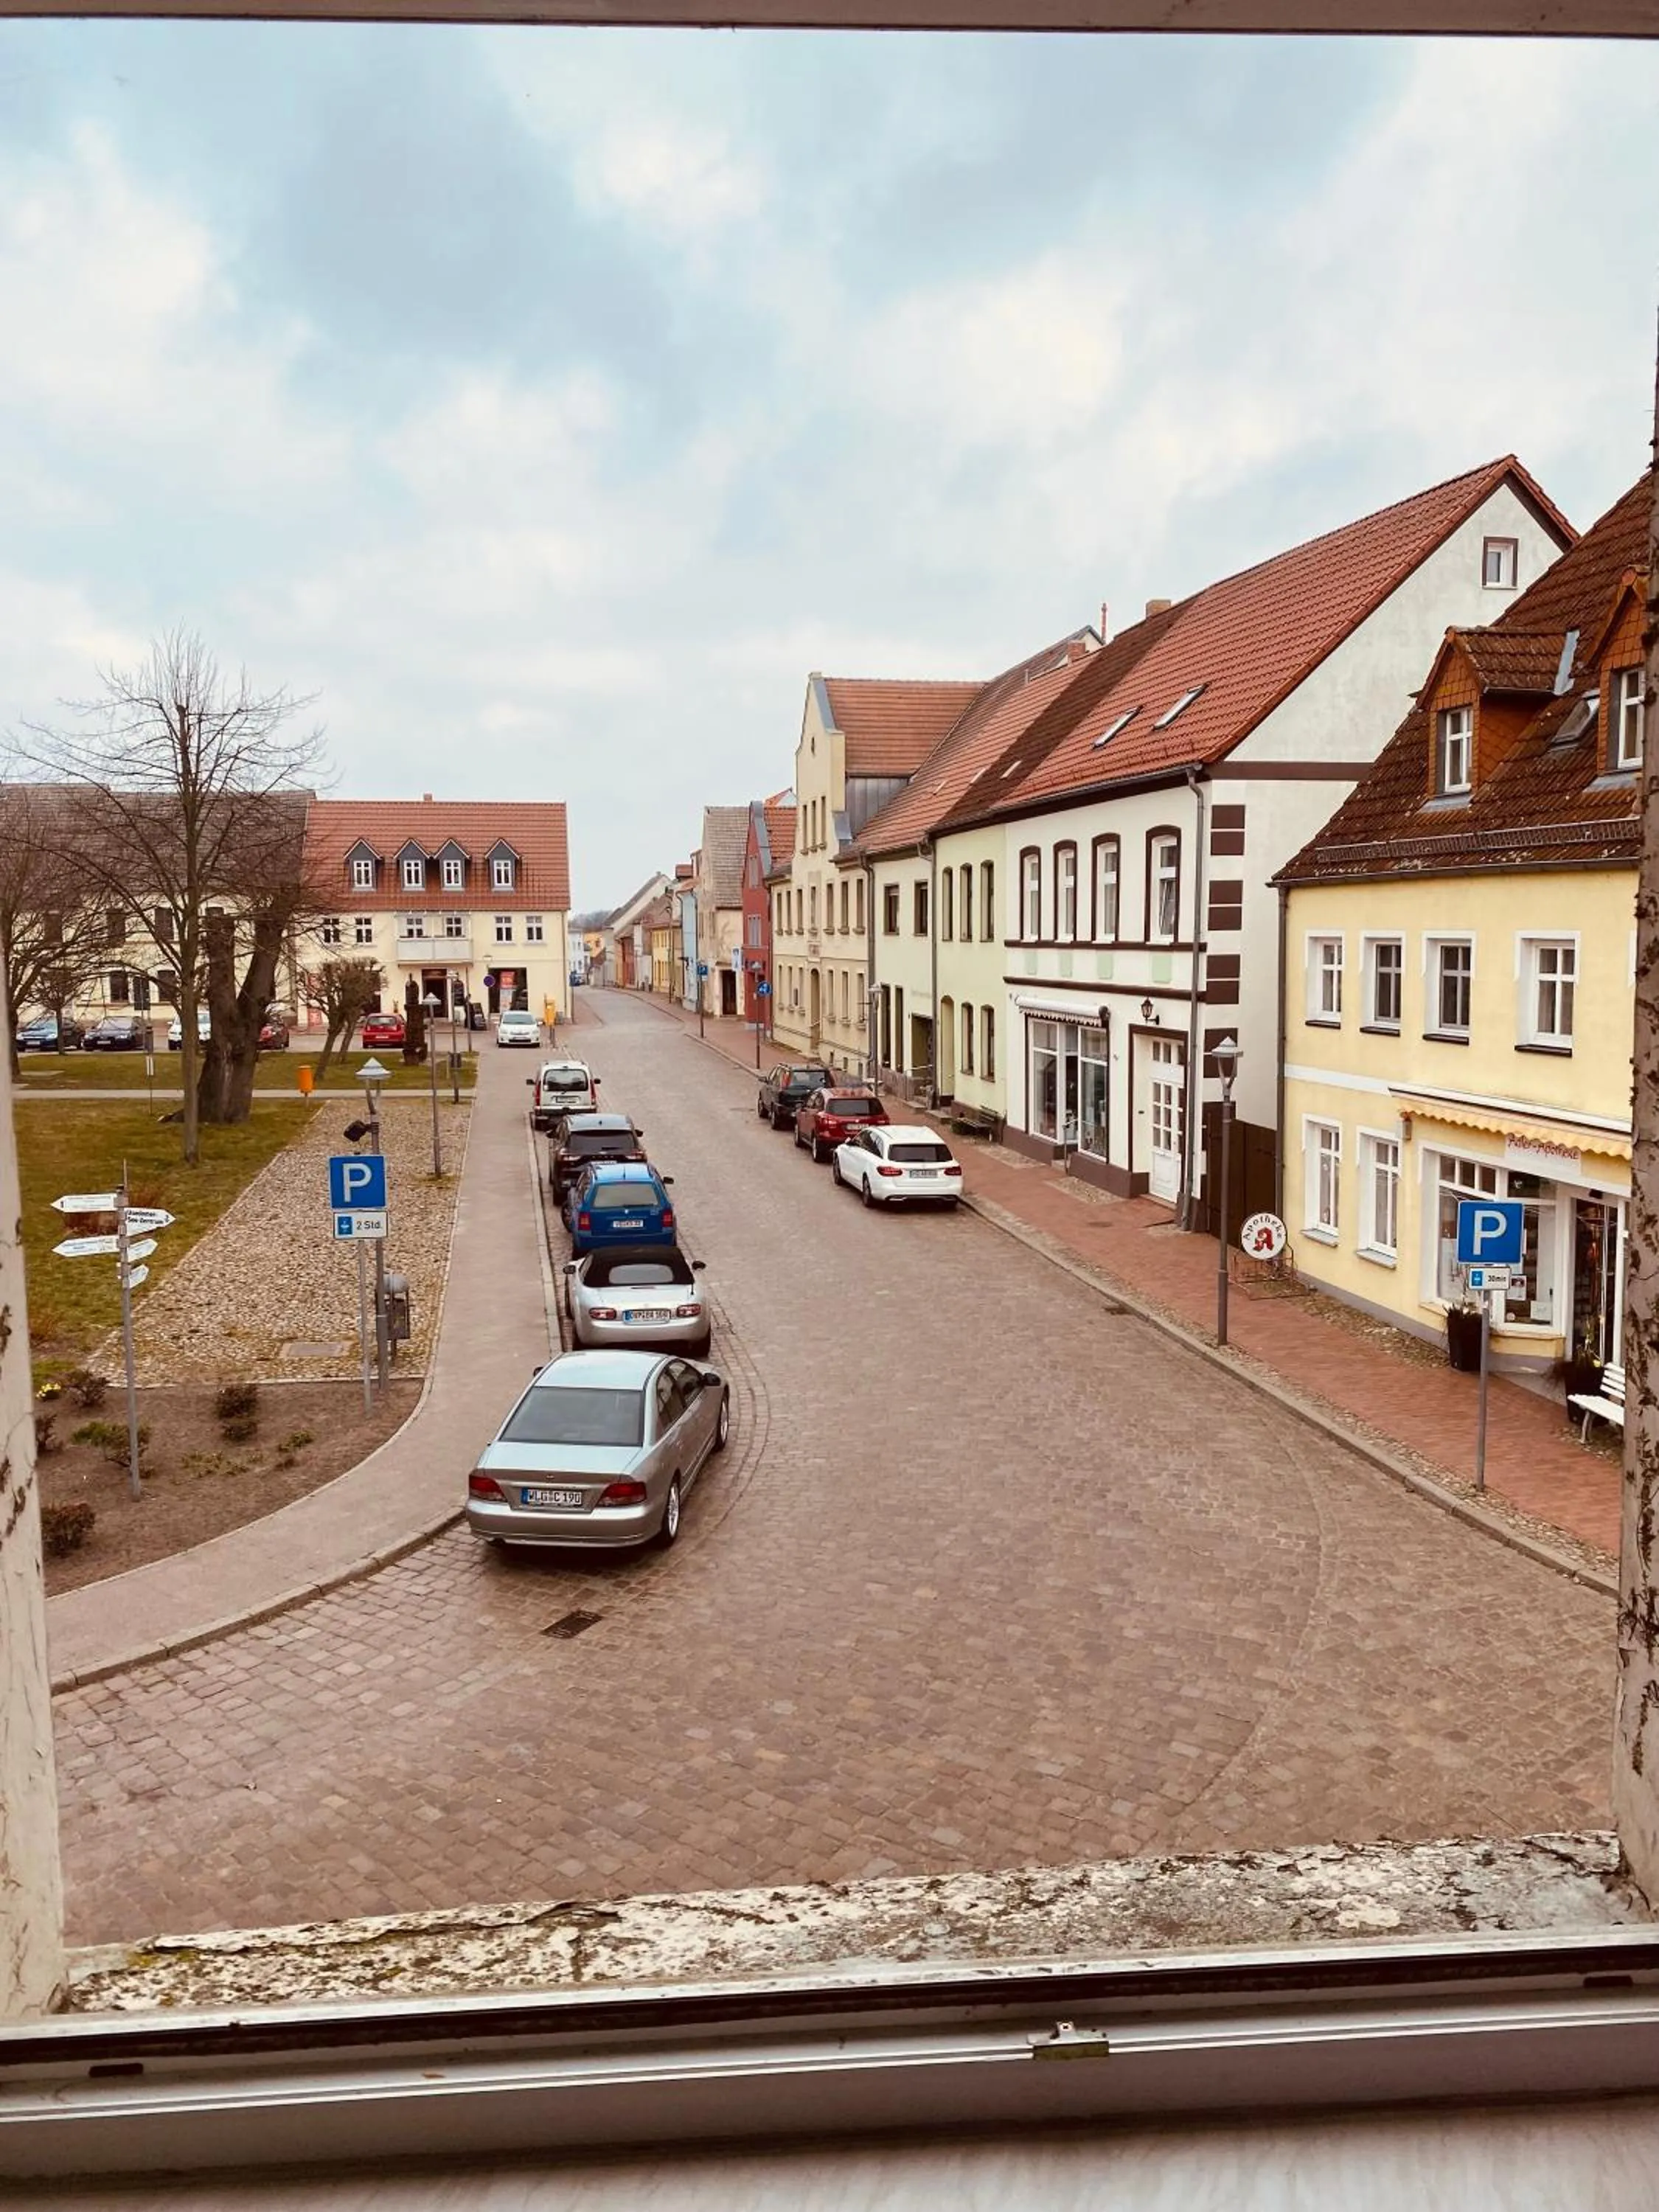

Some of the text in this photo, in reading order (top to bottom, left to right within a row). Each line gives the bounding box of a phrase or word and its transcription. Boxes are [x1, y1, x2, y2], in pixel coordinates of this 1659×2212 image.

[342, 1163, 372, 1203] P
[356, 1221, 362, 1230] 2
[1242, 1215, 1282, 1240] Apotheke
[1472, 1210, 1507, 1256] P
